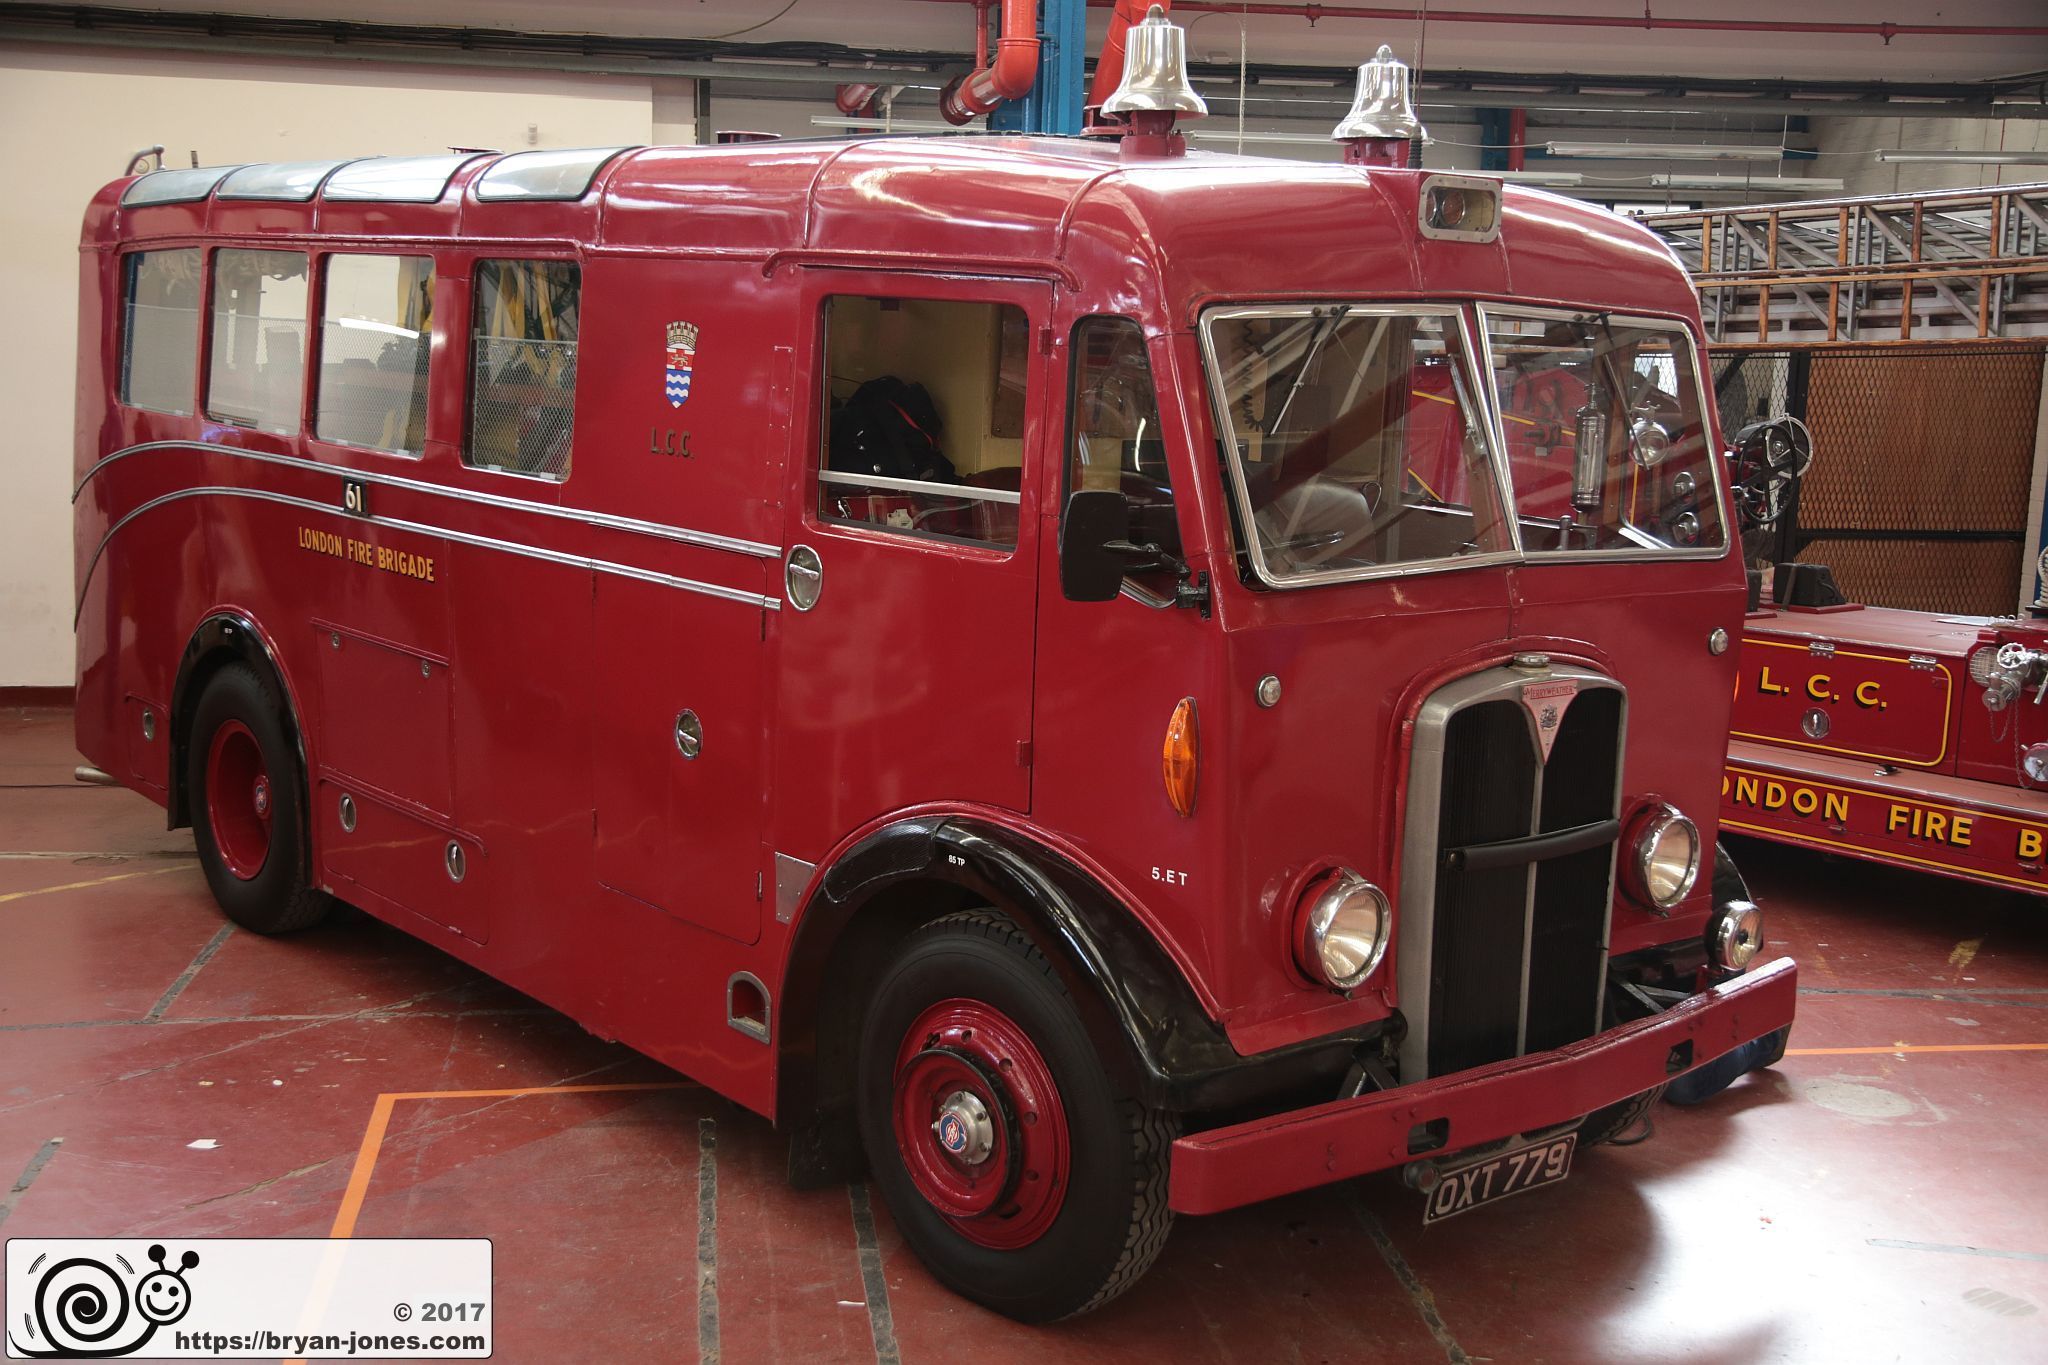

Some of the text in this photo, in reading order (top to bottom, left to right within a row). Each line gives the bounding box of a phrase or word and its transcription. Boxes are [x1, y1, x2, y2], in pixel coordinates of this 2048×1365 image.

[345, 483, 362, 512] 61
[299, 526, 435, 582] LONDON FIRE BRIGADE
[1721, 775, 1849, 822] NDON
[1888, 804, 1974, 846] FIRE
[1435, 1142, 1568, 1215] OXT 779
